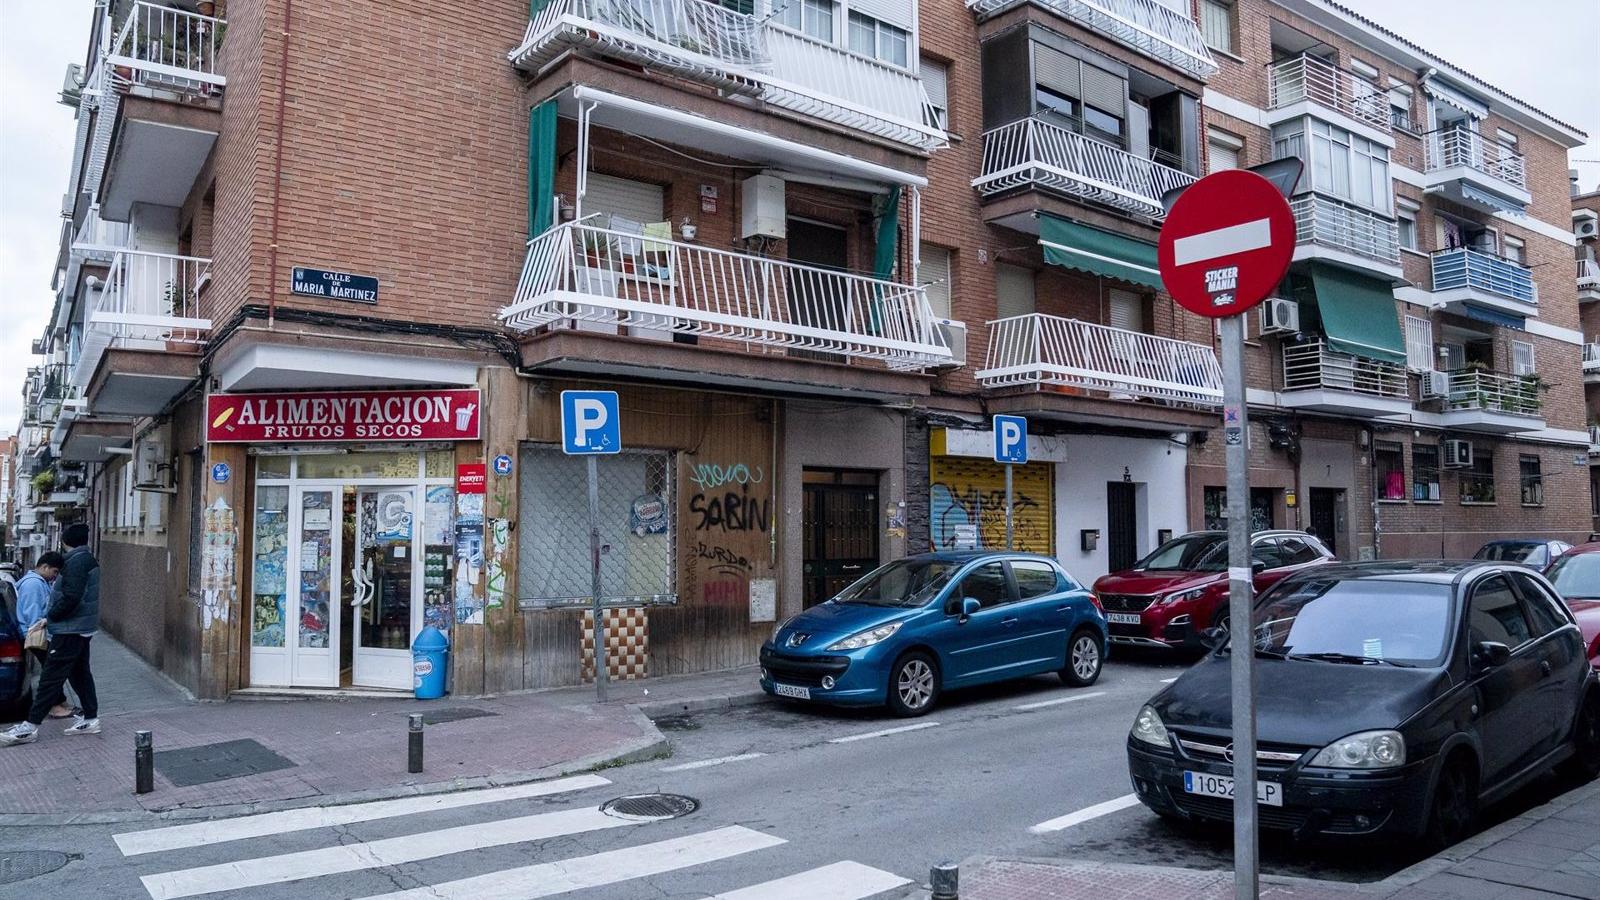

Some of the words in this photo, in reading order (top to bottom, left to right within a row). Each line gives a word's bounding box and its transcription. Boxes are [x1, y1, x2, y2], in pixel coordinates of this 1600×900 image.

[322, 272, 351, 282] CALLE
[1205, 266, 1238, 283] STICKER
[295, 281, 325, 295] MARIA
[330, 286, 376, 301] MARTINEZ
[1208, 277, 1236, 292] MANIA
[237, 396, 452, 425] ALIMENTACION
[264, 425, 345, 438] FRUTOS
[355, 424, 422, 437] SECOS
[574, 398, 608, 447] P
[1001, 421, 1021, 457] P
[1108, 613, 1125, 622] 7438
[1198, 775, 1234, 797] 1052
